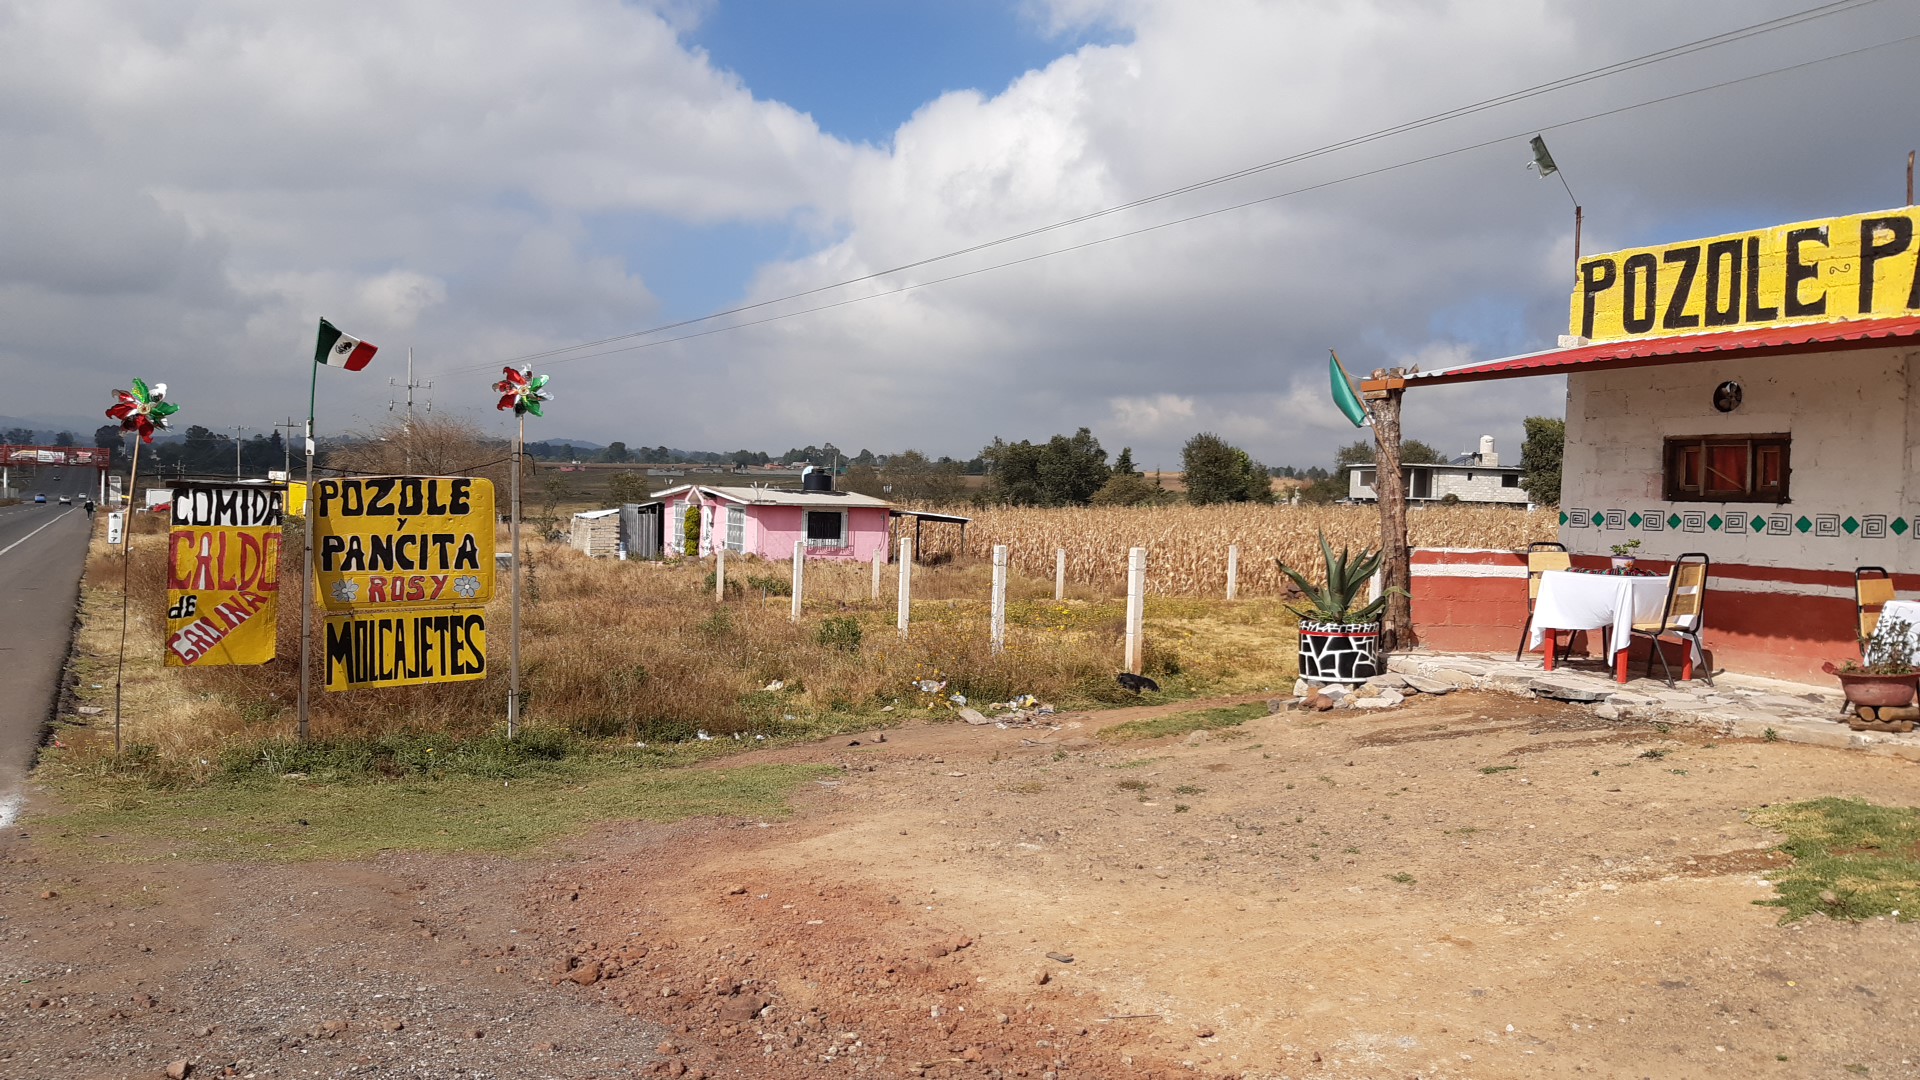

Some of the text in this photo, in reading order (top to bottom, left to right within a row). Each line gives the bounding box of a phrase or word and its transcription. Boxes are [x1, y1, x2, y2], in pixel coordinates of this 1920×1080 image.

[1580, 215, 1920, 339] POZOLE P
[172, 489, 283, 526] COMIDA
[320, 479, 471, 517] POZOLE
[167, 530, 282, 591] CALDO
[321, 533, 480, 571] PANCITA
[368, 575, 449, 602] ROSY
[167, 591, 269, 666] GALLINA
[326, 614, 485, 685] MOLCAJETES
